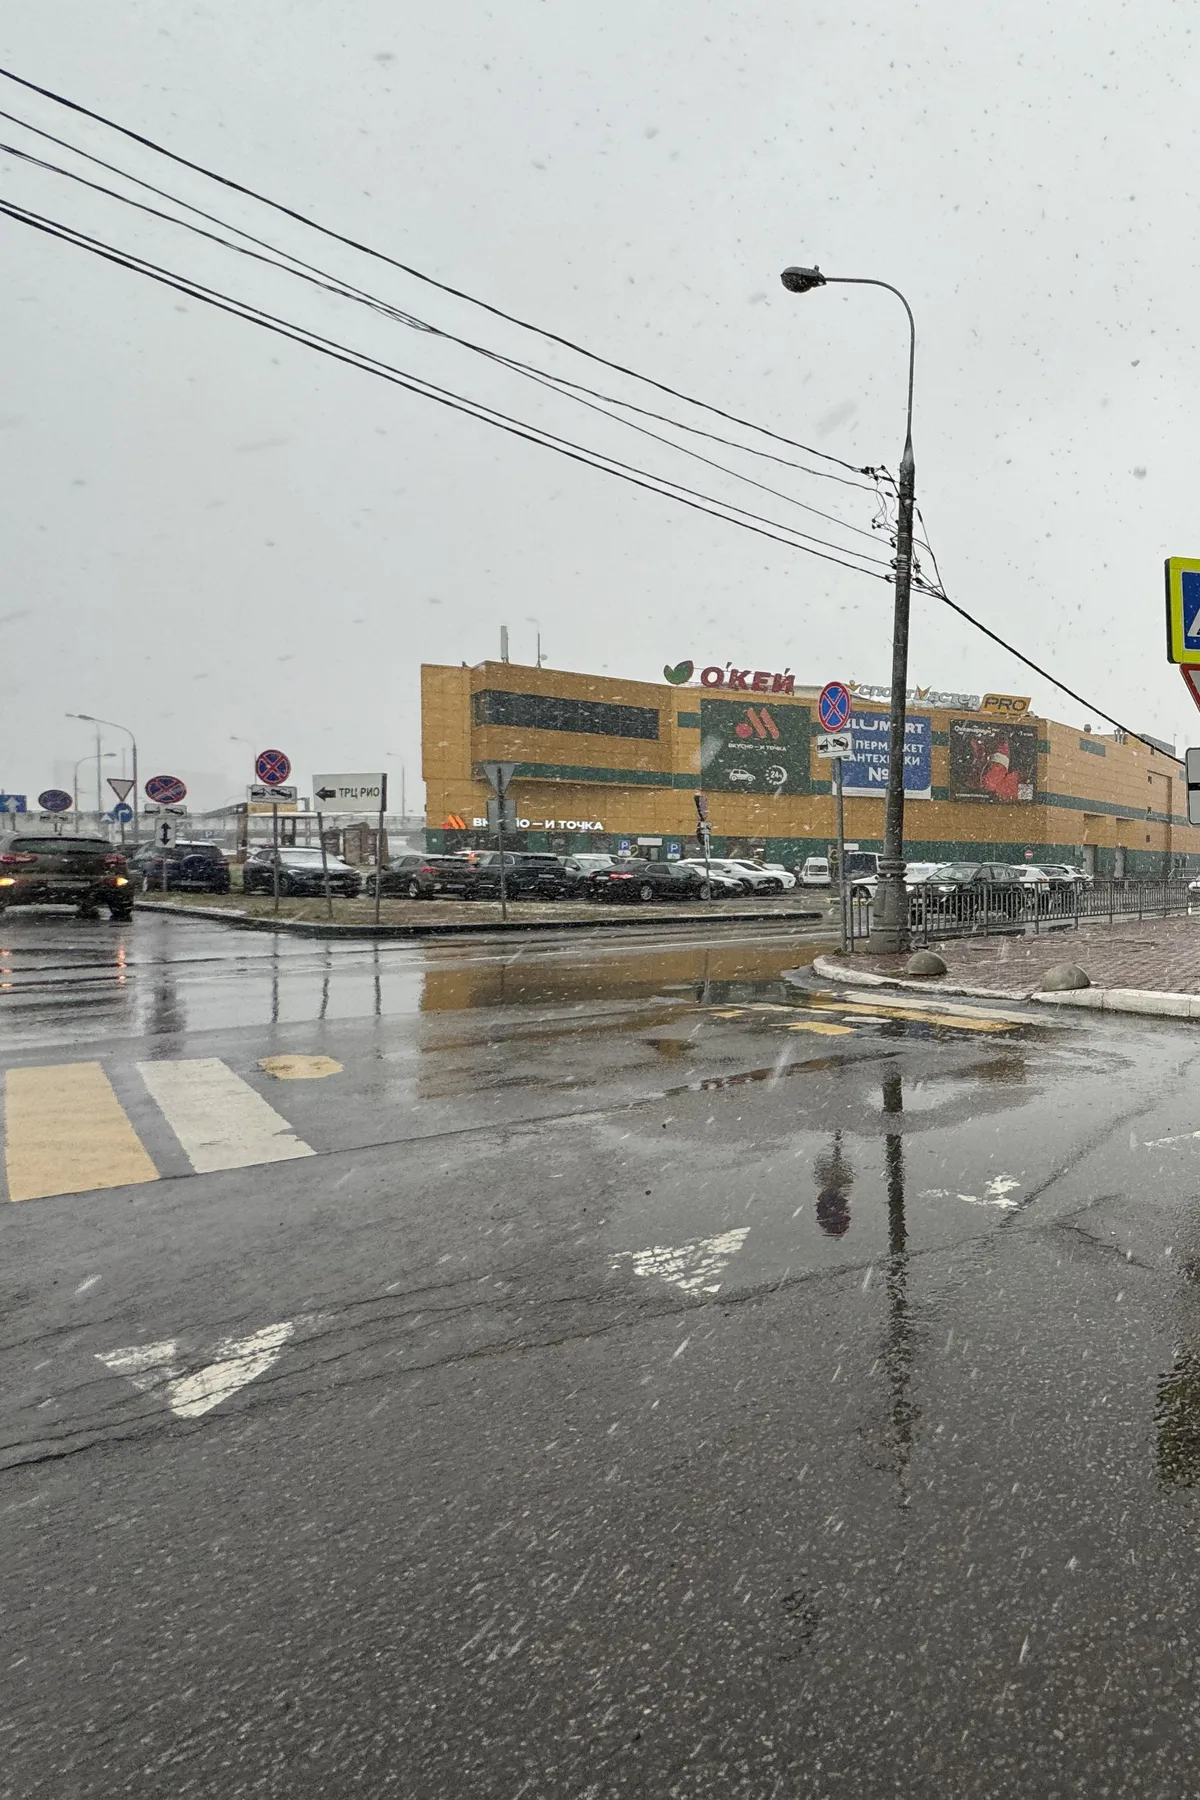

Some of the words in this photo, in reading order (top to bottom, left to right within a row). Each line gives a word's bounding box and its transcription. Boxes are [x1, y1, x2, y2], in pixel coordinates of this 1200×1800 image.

[984, 696, 1028, 712] PRO
[339, 787, 358, 799] ТРЦ
[360, 787, 380, 797] РИО
[545, 820, 555, 829] И
[558, 820, 604, 831] ТОЧКА
